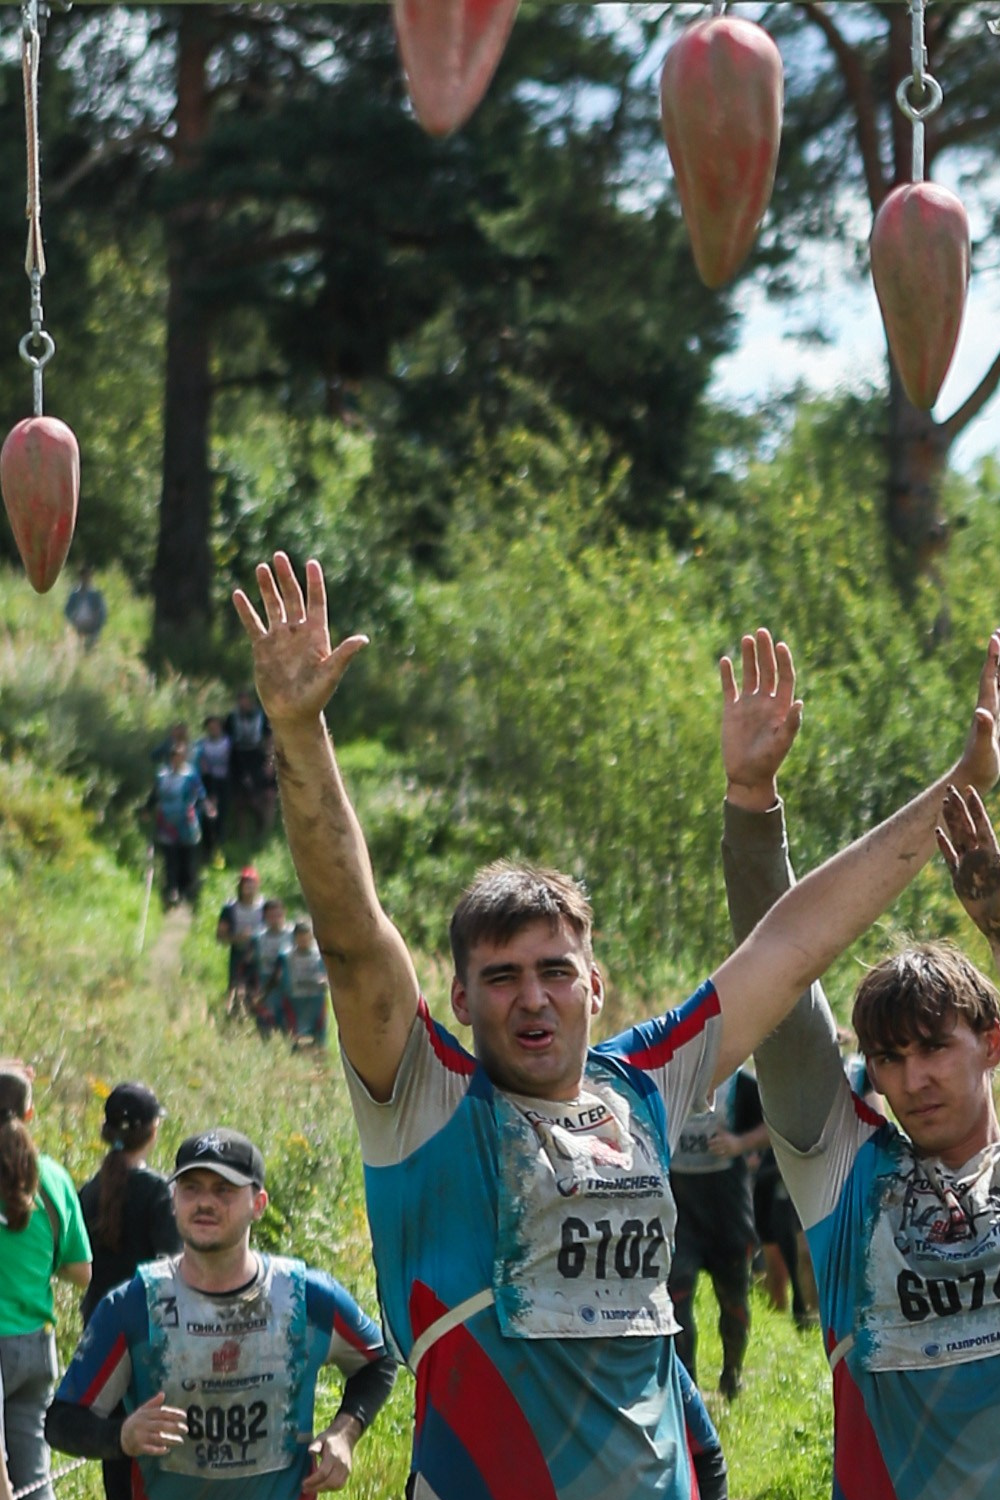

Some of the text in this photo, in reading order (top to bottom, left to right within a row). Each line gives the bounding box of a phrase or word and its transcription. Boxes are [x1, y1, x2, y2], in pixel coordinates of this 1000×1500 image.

[557, 1216, 666, 1280] 6102
[186, 1322, 222, 1333] ГОНКА
[187, 1400, 268, 1444] 6082
